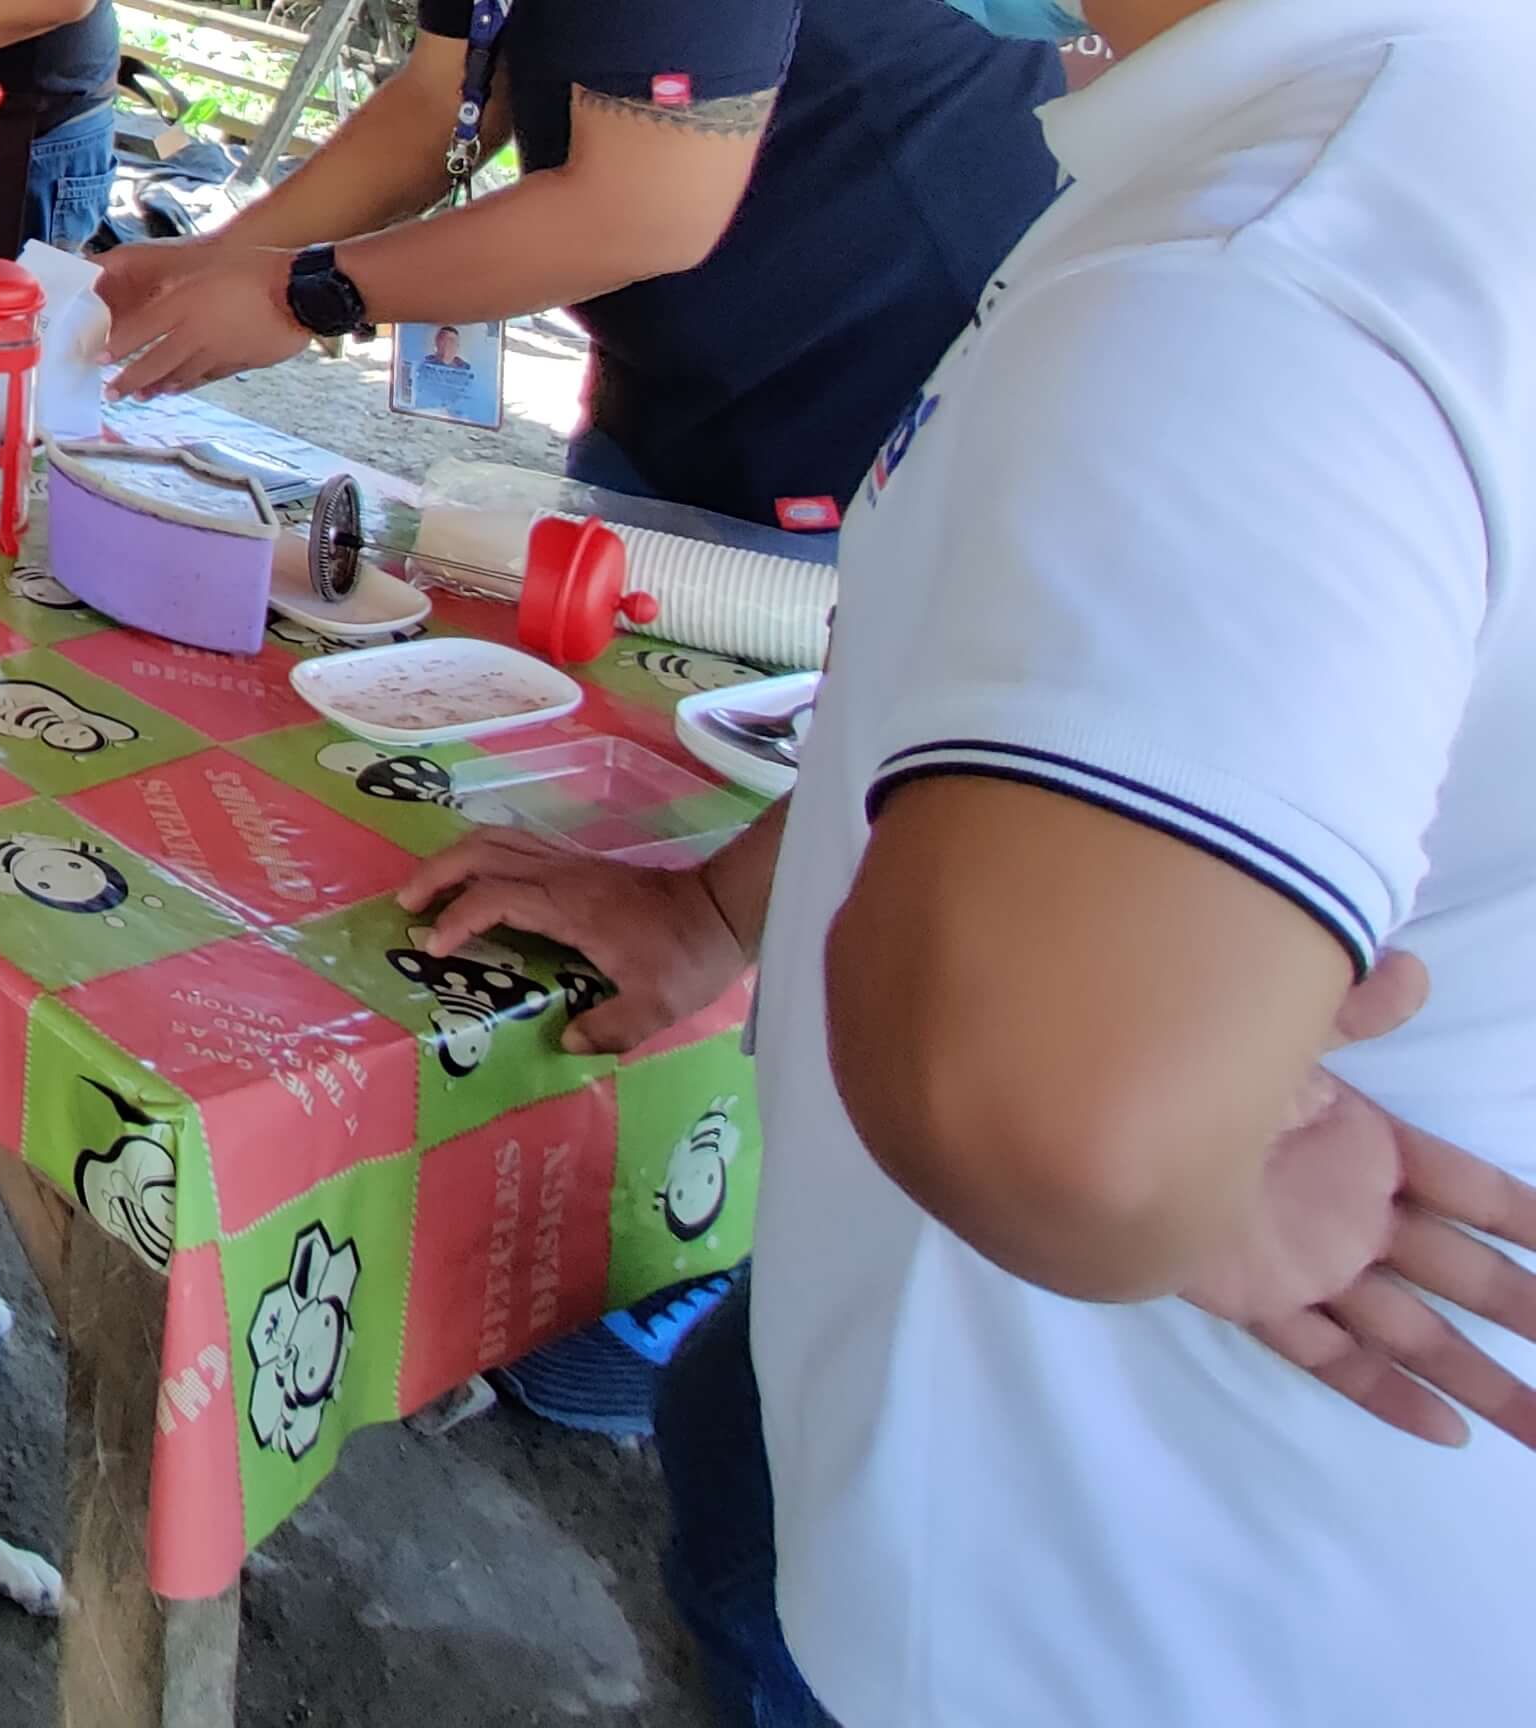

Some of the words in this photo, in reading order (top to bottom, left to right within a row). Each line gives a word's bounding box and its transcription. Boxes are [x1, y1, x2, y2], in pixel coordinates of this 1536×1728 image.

[169, 988, 285, 1028] VICTORY
[213, 1017, 300, 1047] AIMED
[225, 1035, 272, 1057] ALL
[184, 1042, 253, 1070] GAVE
[314, 1043, 368, 1089] THEY
[270, 1068, 314, 1116] THEY
